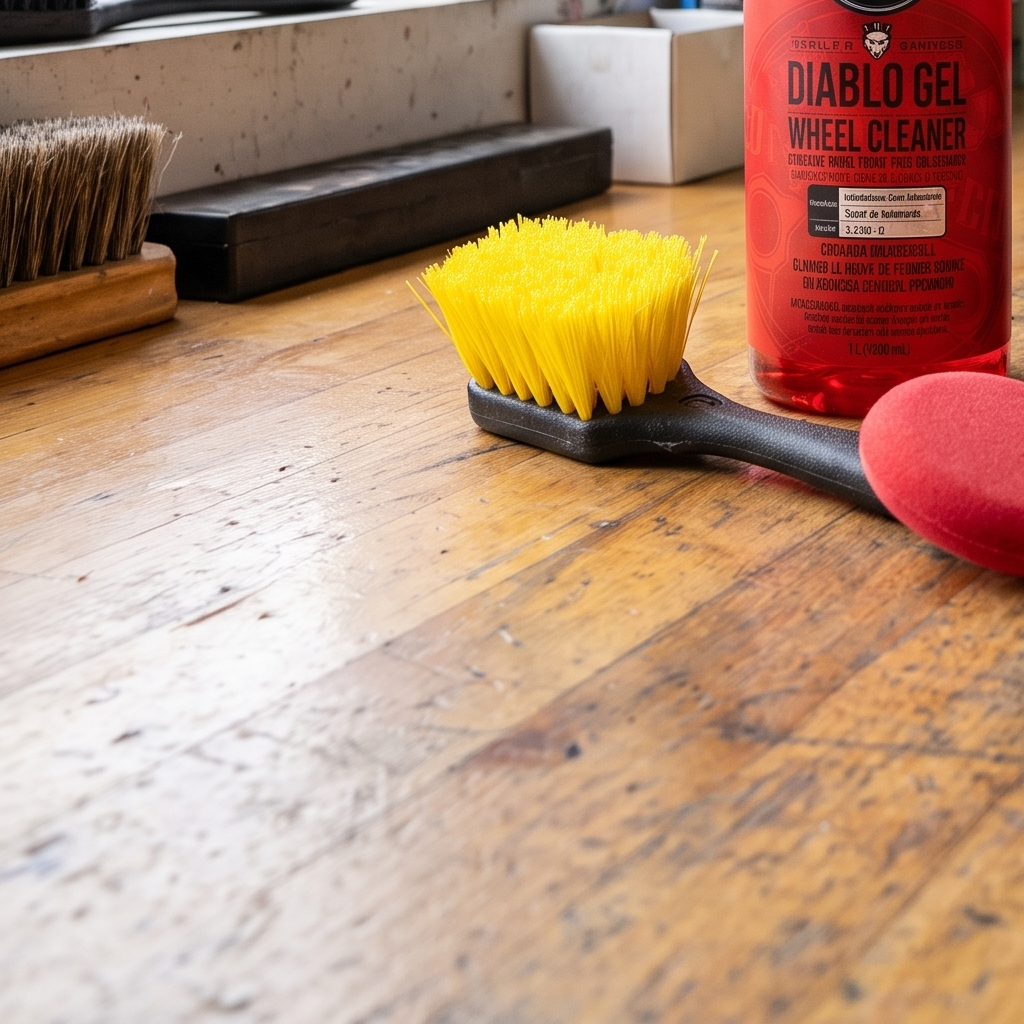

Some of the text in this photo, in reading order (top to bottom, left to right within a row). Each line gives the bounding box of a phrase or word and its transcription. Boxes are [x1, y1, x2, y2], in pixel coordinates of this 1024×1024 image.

[788, 60, 967, 108] DIABLO GEL
[788, 116, 861, 152] WHEEL
[867, 116, 967, 153] CLEANER
[878, 262, 890, 275] DE
[855, 343, 862, 355] L
